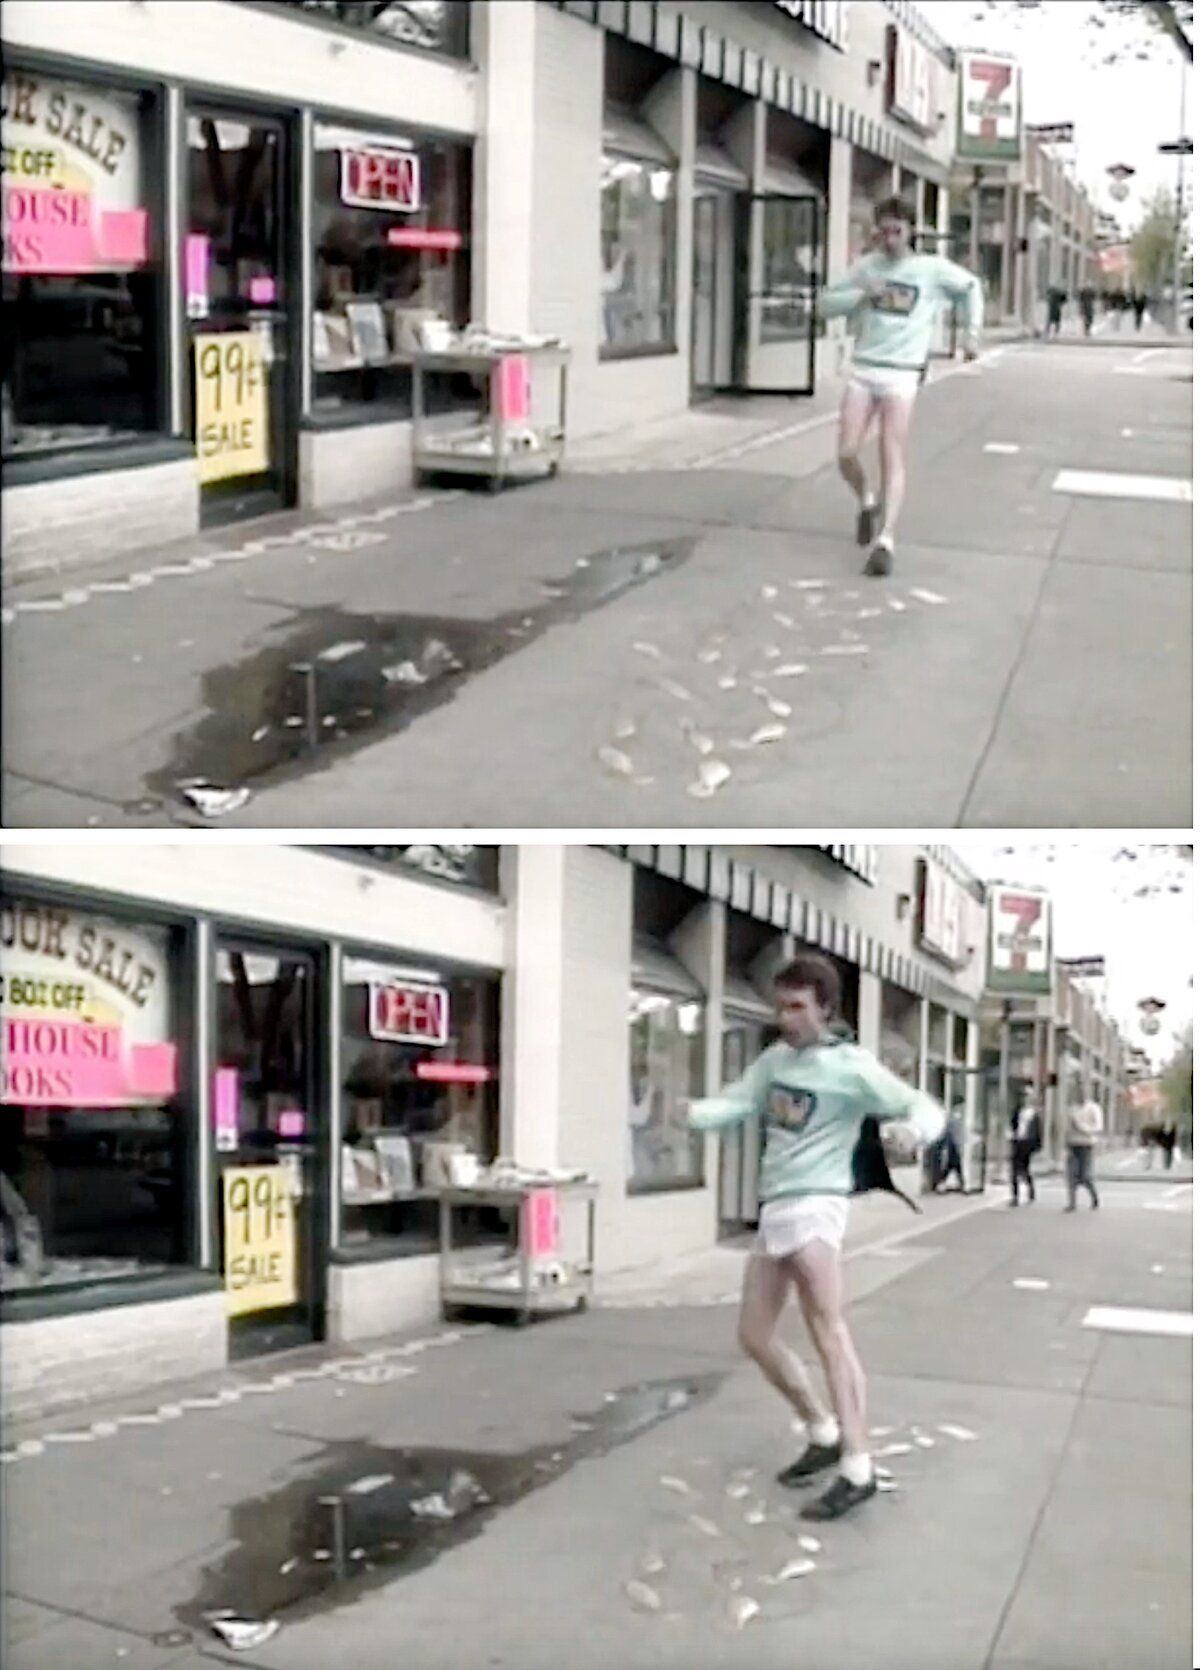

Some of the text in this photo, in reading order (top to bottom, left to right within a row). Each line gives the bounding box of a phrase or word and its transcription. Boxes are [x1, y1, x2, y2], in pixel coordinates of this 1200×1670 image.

[46, 92, 126, 176] SALE
[21, 150, 55, 175] OFF
[346, 152, 413, 205] OPEN
[202, 418, 253, 457] SALE
[76, 926, 155, 1007] SALE
[52, 984, 84, 1010] OFF
[376, 985, 440, 1038] OPEN
[230, 1252, 282, 1289] SALE
